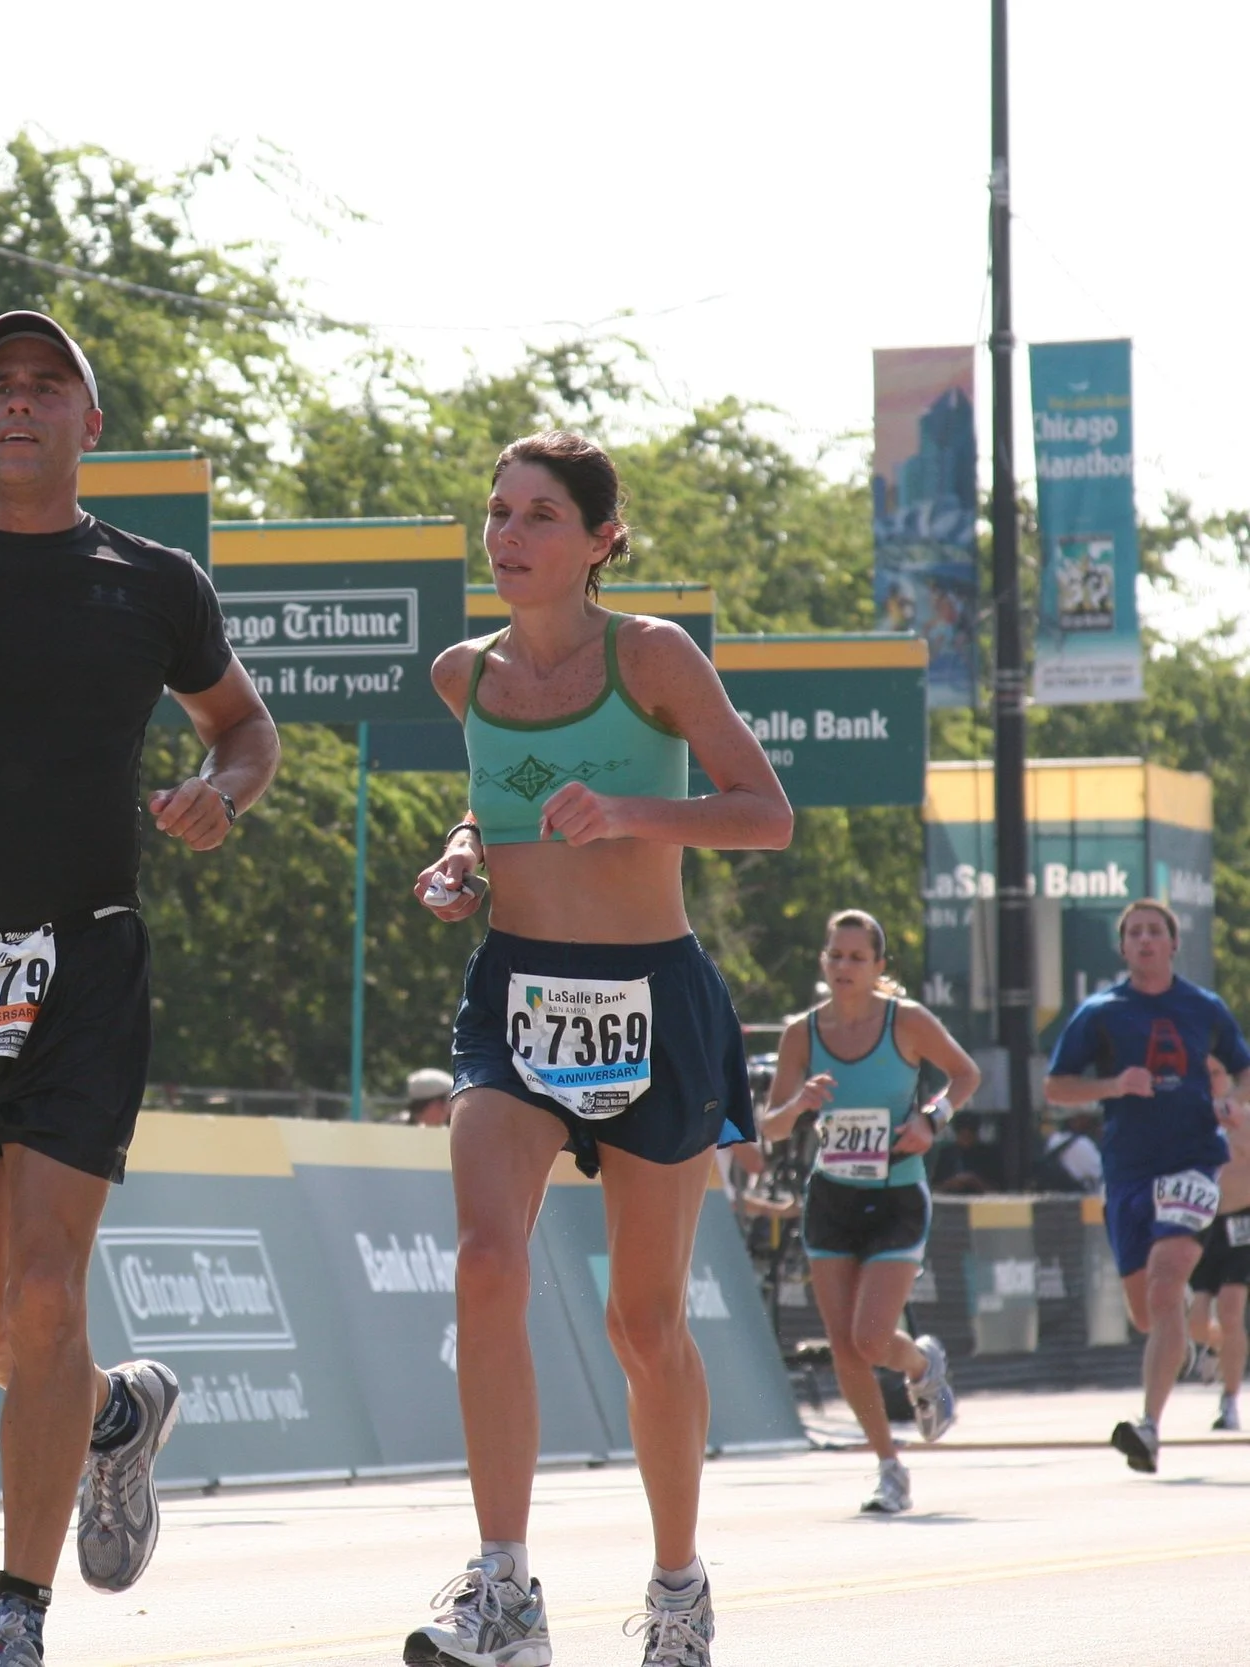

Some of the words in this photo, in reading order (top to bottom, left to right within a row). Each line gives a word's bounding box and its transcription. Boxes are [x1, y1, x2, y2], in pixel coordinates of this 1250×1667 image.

[224, 615, 276, 645] ago
[283, 603, 403, 641] Tribune
[280, 667, 298, 694] it
[304, 666, 339, 694] for
[344, 664, 404, 699] you?
[814, 708, 889, 740] Bank
[1043, 861, 1129, 898] Bank
[548, 989, 591, 1004] LaSalle
[595, 991, 627, 1005] Bank
[557, 1066, 639, 1084] ANNIVERSARY
[835, 1125, 888, 1152] 2017
[354, 1232, 419, 1293] Bank
